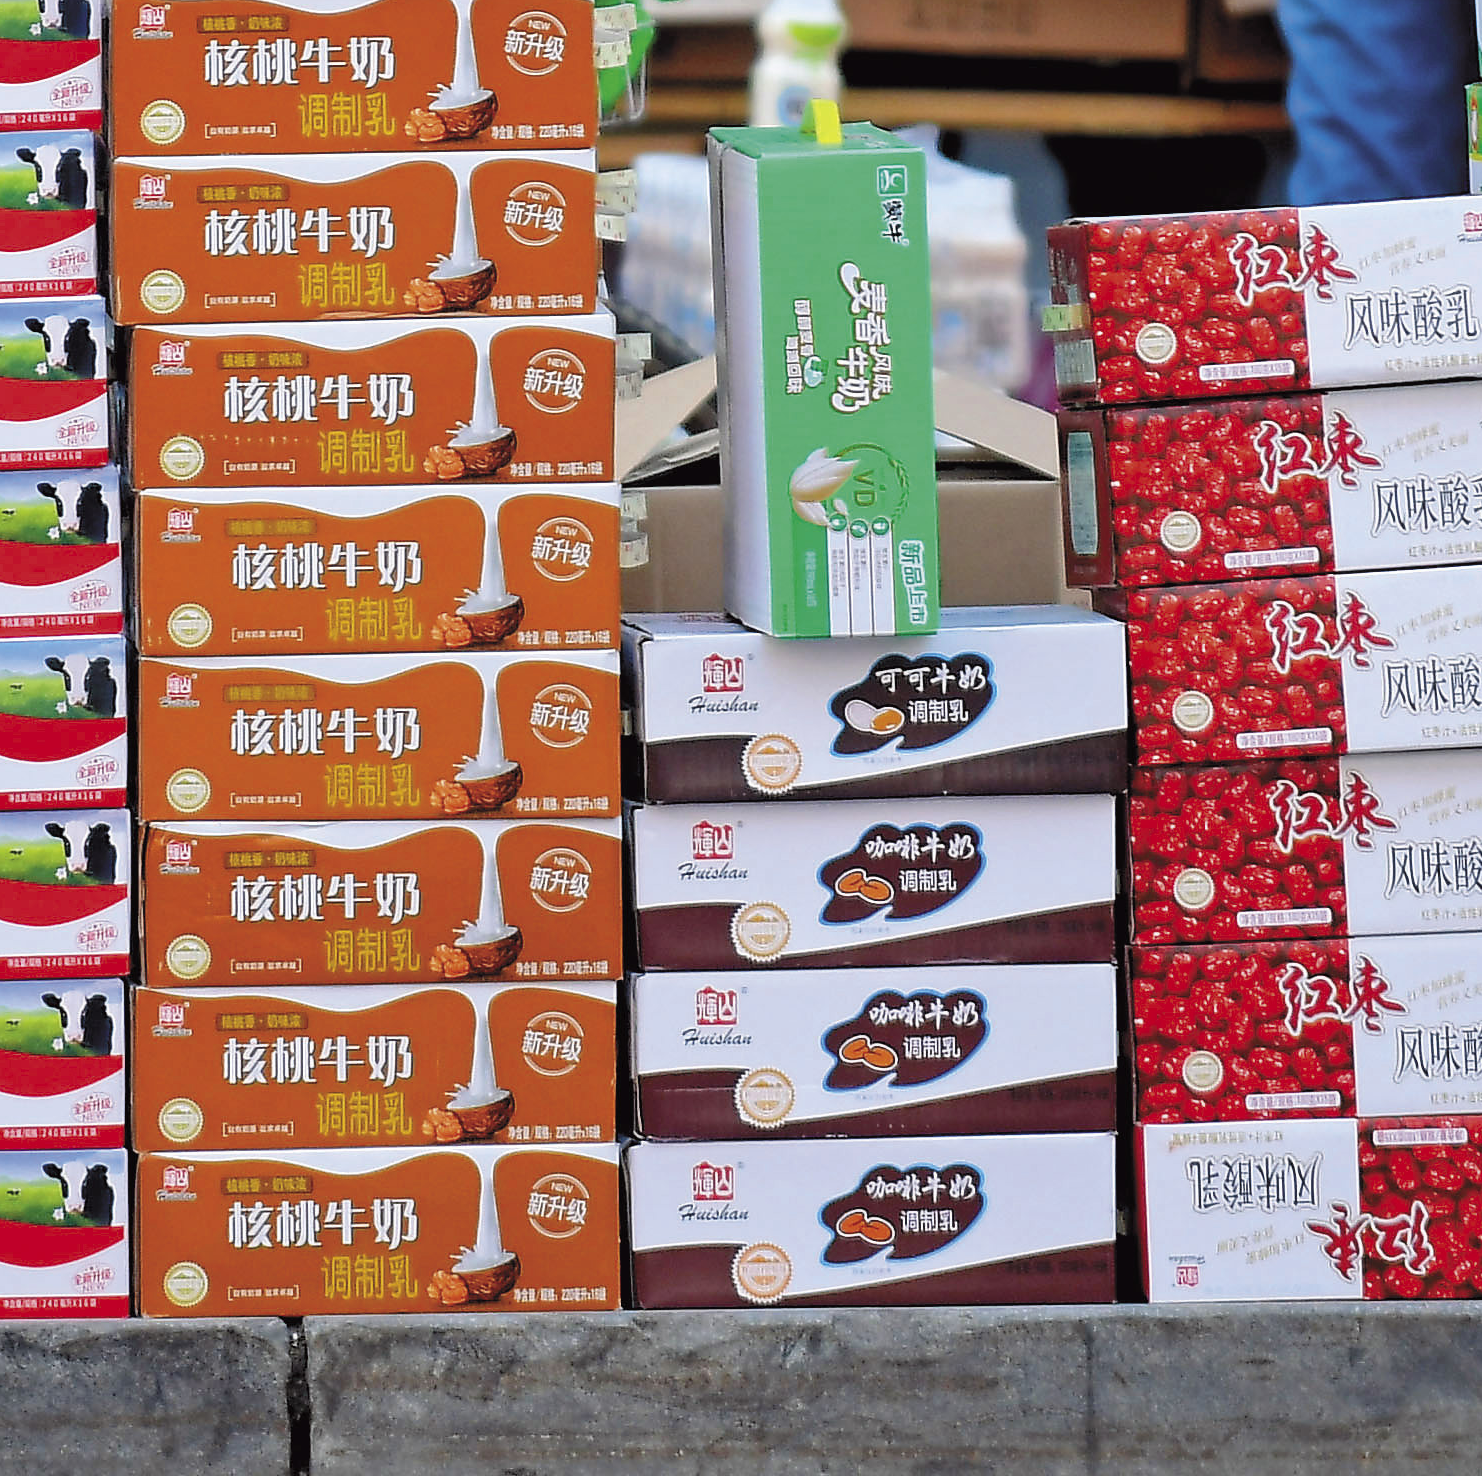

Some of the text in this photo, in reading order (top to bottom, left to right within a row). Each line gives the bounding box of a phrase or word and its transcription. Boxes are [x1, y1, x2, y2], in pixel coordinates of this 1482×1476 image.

[528, 19, 552, 31] NEW
[204, 37, 396, 88] 核桃牛奶
[504, 33, 566, 64] 新升级
[299, 93, 395, 138] 调制乳
[204, 207, 396, 258] 核桃牛奶
[881, 199, 904, 245] 蒙牛
[299, 263, 395, 308] 调制乳
[1228, 223, 1359, 306] 红枣
[1346, 286, 1480, 350] 风味酸乳
[547, 357, 571, 369] NEW
[224, 374, 416, 425] 核桃牛奶
[523, 371, 585, 402] 新升级
[318, 430, 414, 475] 调制乳
[1252, 410, 1383, 493] 红枣
[231, 541, 423, 592] 核桃牛奶
[899, 538, 928, 625] 新品上市
[326, 597, 422, 642] 调制乳
[1265, 591, 1396, 674] 红枣
[876, 664, 986, 692] 可可牛奶
[688, 694, 759, 714] Huishan
[907, 701, 970, 723] 调制乳
[230, 707, 422, 758] 核桃牛奶
[324, 764, 420, 809] 调制乳
[1268, 771, 1399, 854] 红枣
[865, 833, 976, 864] 咖啡牛奶
[677, 861, 749, 882] Huishan
[898, 869, 958, 893] 调制乳
[230, 873, 422, 924] 核桃牛奶
[324, 929, 420, 974] 调制乳
[869, 1000, 980, 1031] 咖啡牛奶
[1277, 954, 1408, 1037] 红枣
[681, 1027, 753, 1048] Huishan
[902, 1036, 962, 1060] 调制乳
[222, 1036, 414, 1087] 核桃牛奶
[316, 1092, 412, 1137] 调制乳
[866, 1173, 977, 1204] 咖啡牛奶
[1186, 1150, 1320, 1214] 风味酸乳
[228, 1199, 420, 1250] 核桃牛奶
[899, 1209, 959, 1233] 调制乳
[1304, 1199, 1435, 1282] 红枣
[322, 1255, 418, 1300] 调制乳
